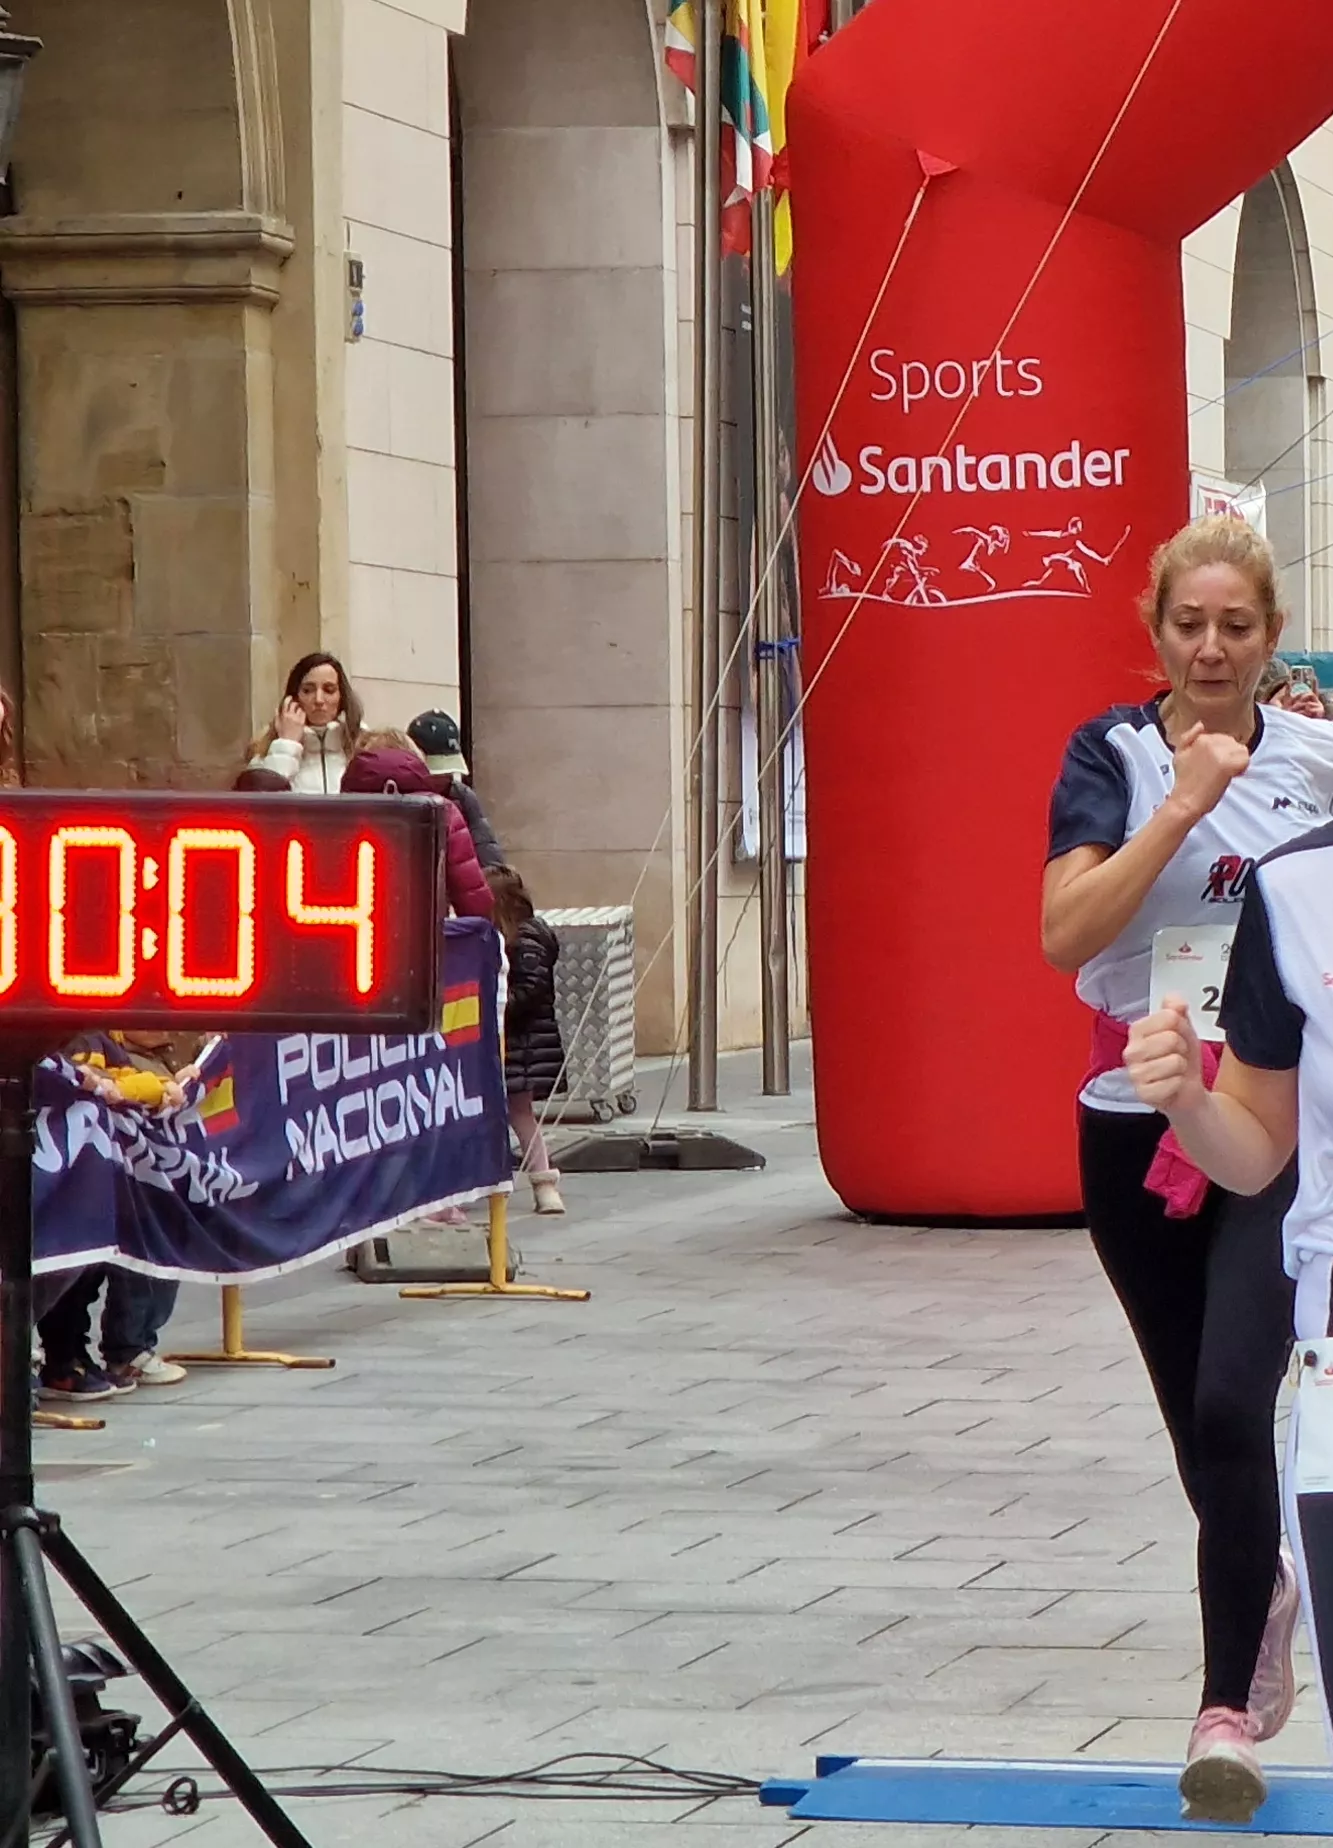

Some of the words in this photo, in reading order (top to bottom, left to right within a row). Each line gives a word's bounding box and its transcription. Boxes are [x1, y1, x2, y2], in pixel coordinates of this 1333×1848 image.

[869, 348, 1043, 414] Sports
[859, 439, 1130, 495] Santander
[0, 826, 375, 997] 0:04
[285, 1059, 484, 1181] NACIONAL
